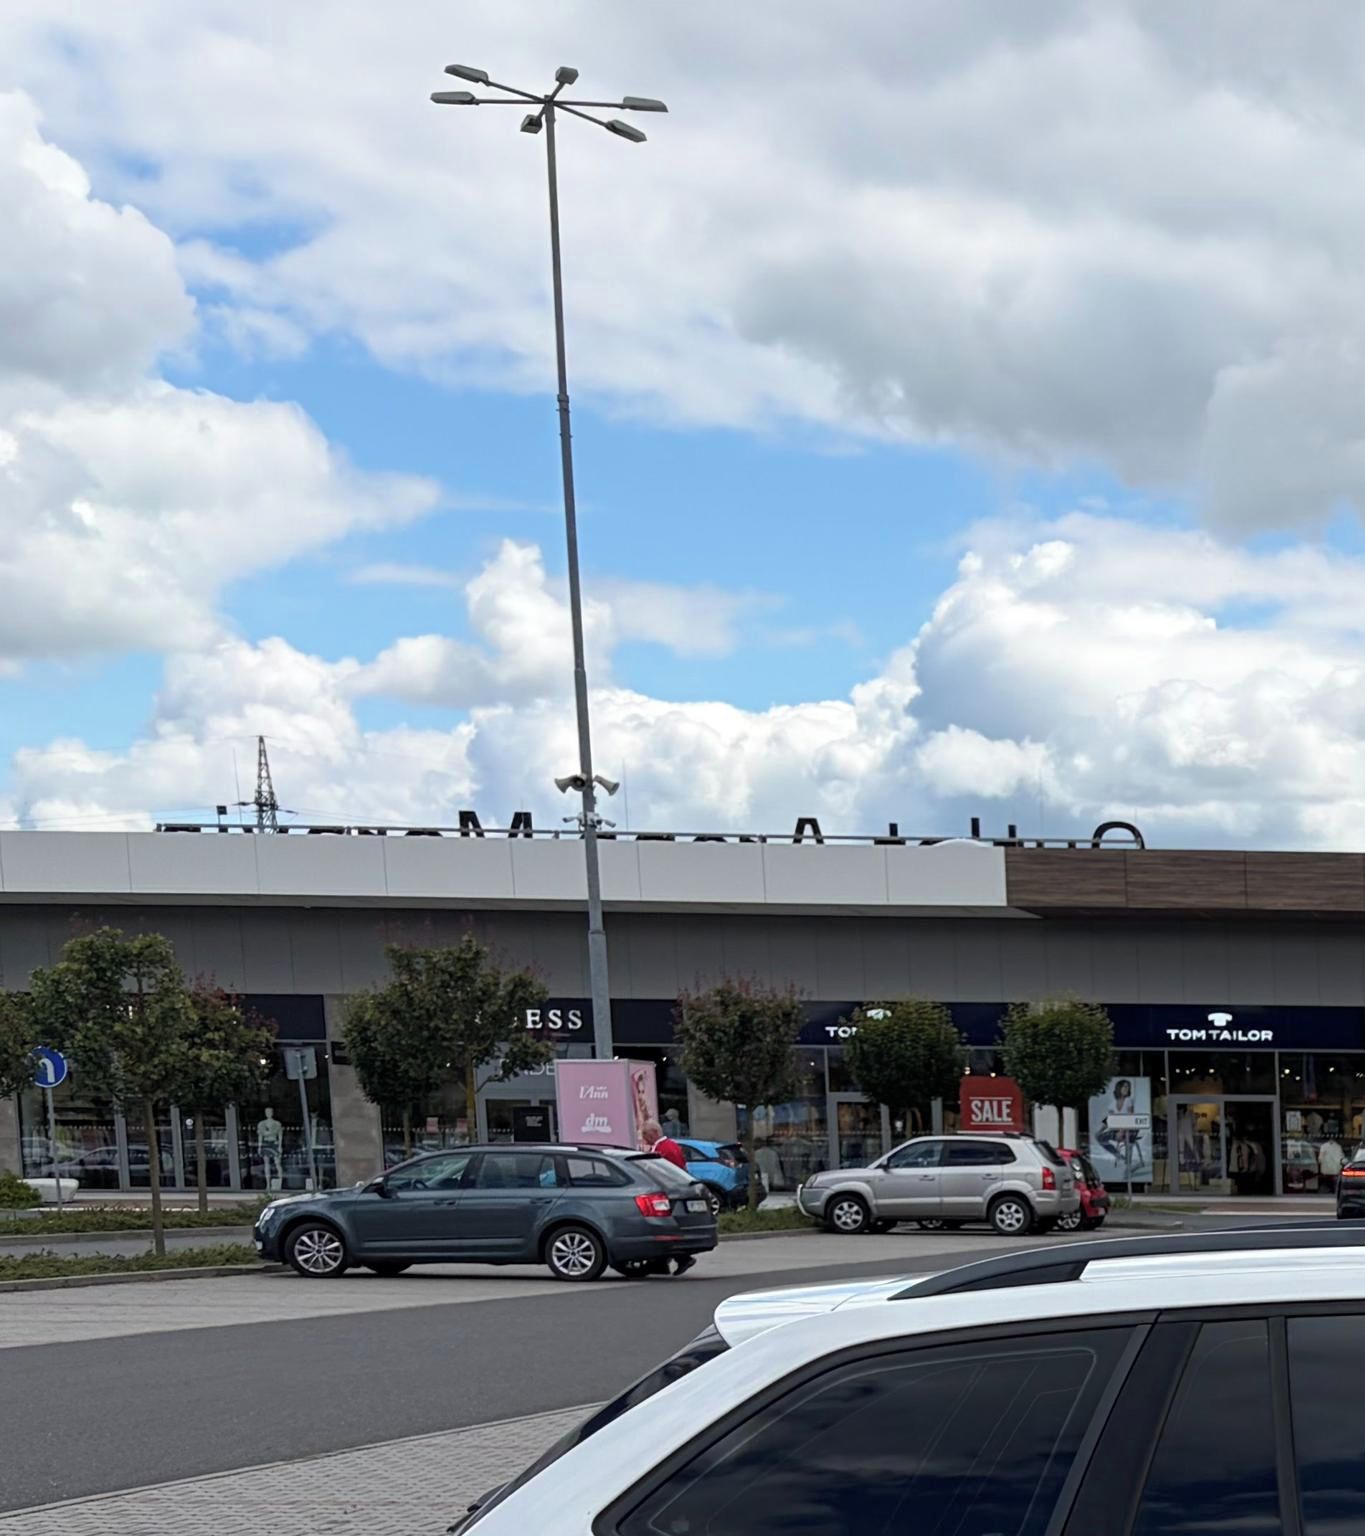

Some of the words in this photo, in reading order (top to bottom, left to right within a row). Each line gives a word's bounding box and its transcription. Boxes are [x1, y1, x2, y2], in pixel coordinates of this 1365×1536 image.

[1166, 1029, 1206, 1041] TOM
[1208, 1029, 1274, 1042] TAILOR
[970, 1100, 1013, 1122] SALE
